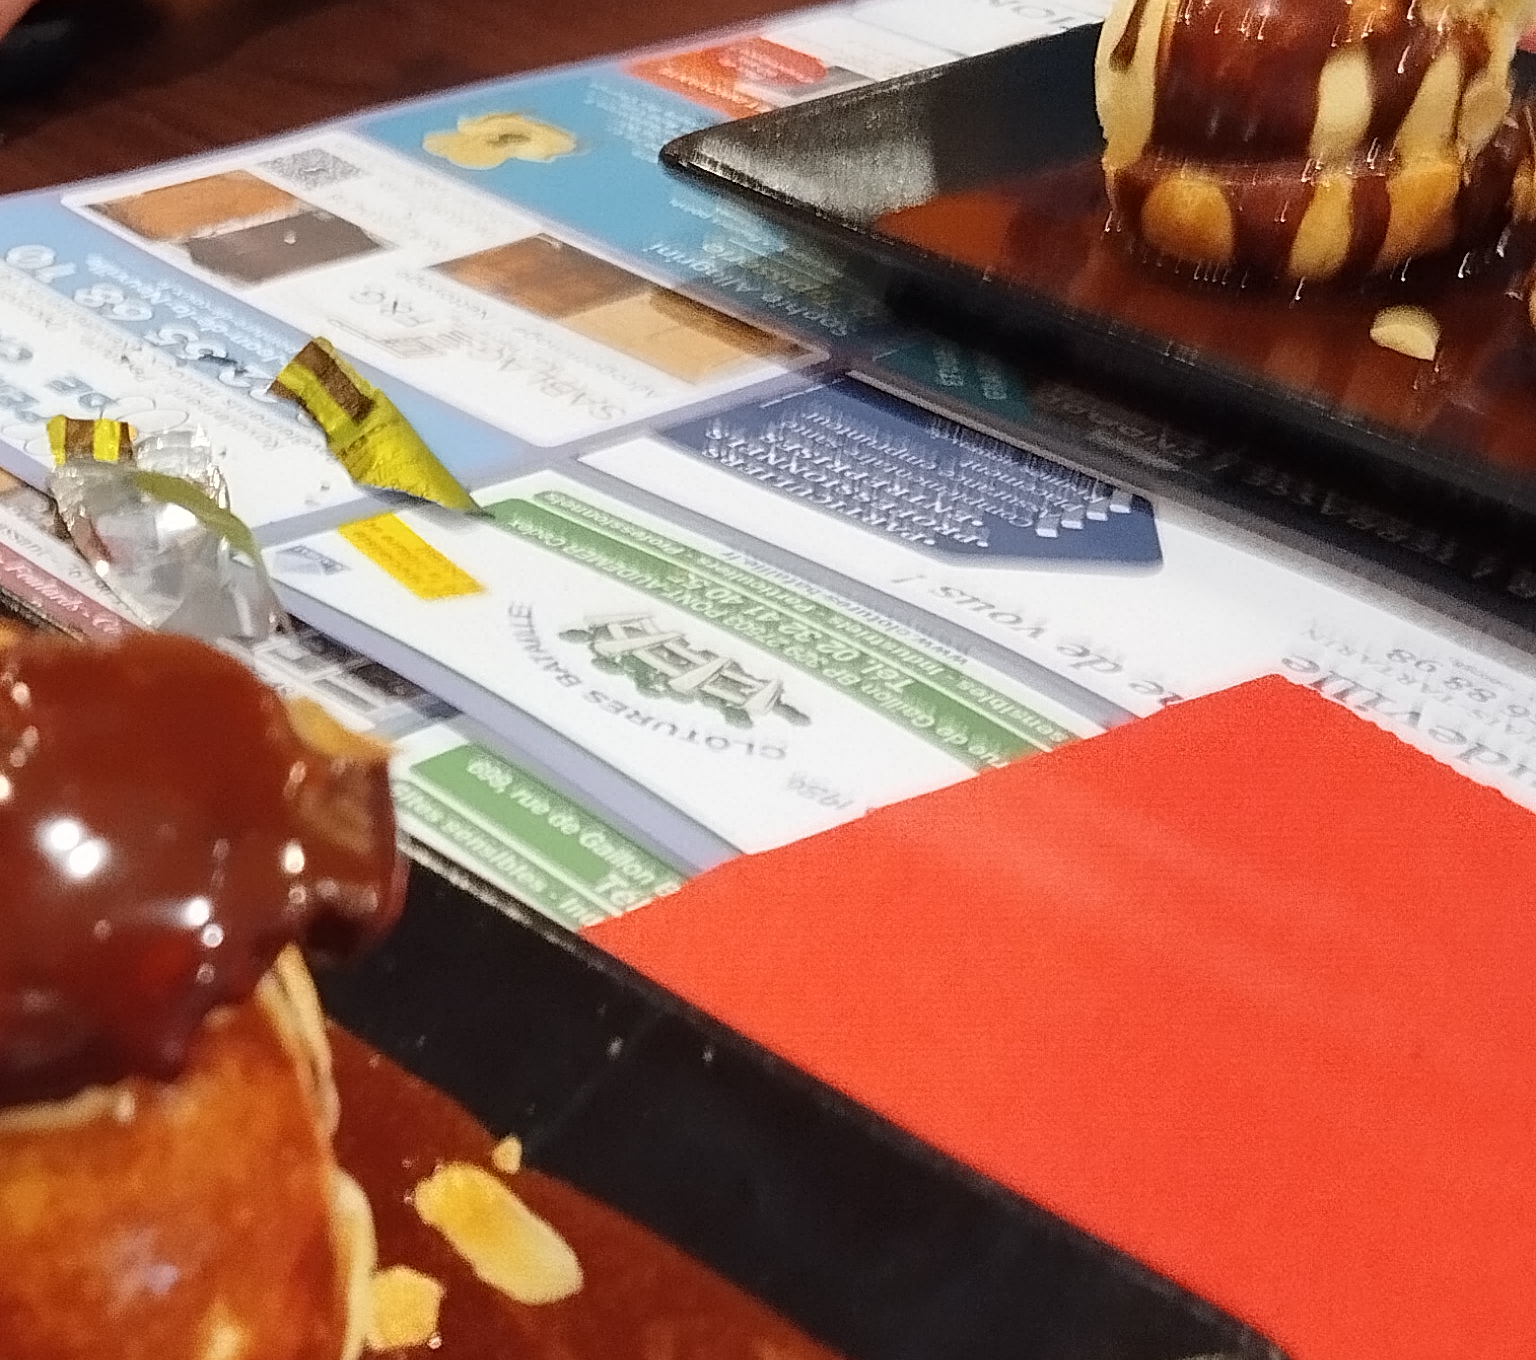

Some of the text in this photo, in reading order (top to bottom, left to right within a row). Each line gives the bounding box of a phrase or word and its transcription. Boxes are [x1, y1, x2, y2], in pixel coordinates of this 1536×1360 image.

[577, 687, 796, 760] CLOTURES
[852, 682, 939, 728] Gaillon
[929, 725, 971, 746] de
[574, 828, 660, 886] Gaillon
